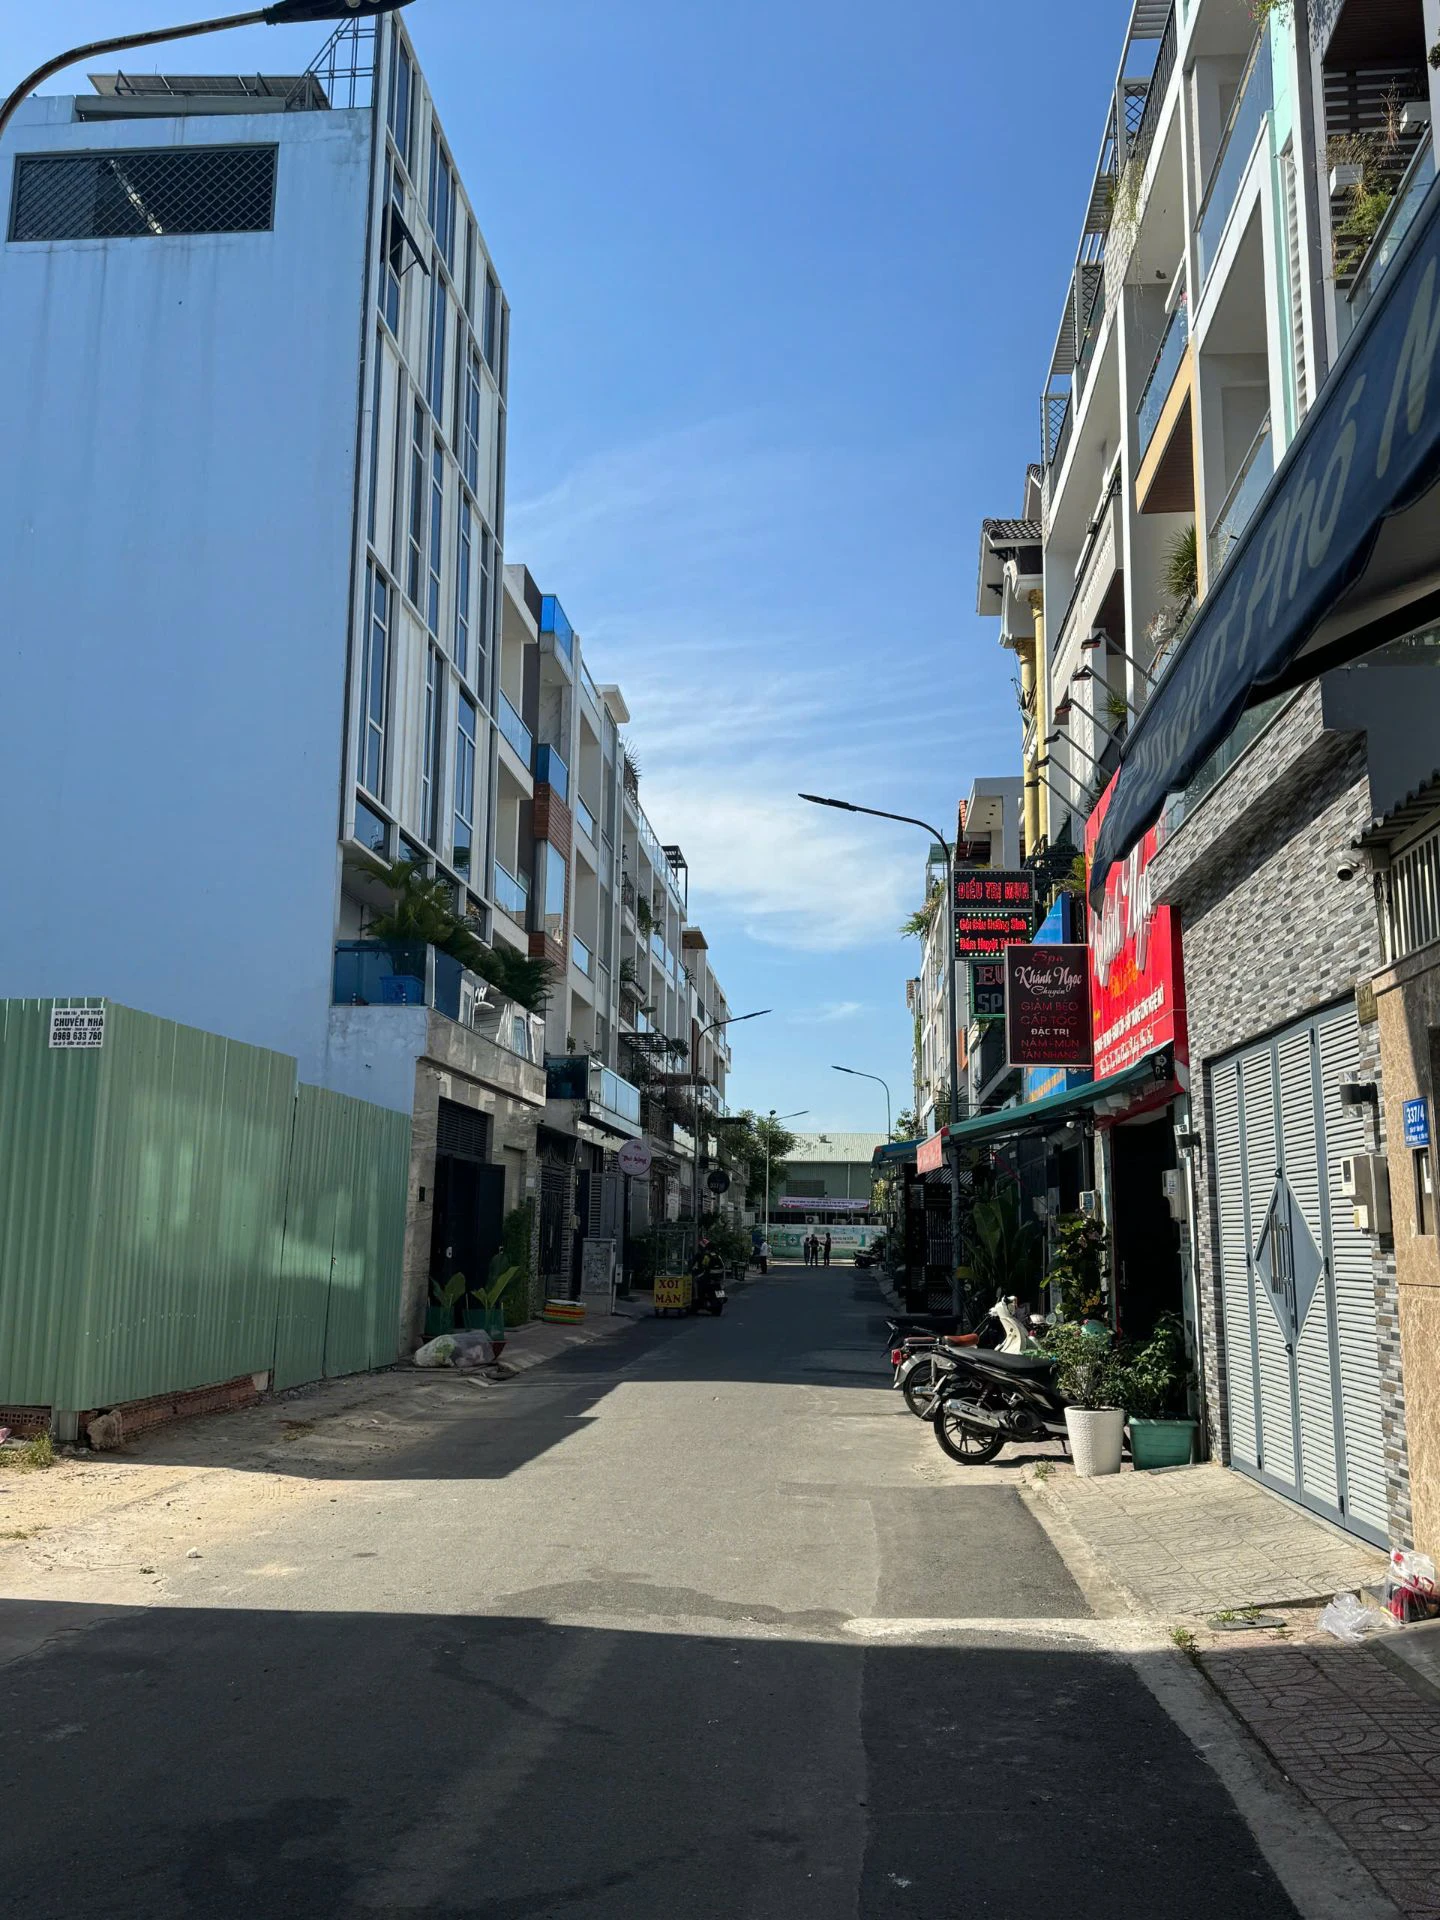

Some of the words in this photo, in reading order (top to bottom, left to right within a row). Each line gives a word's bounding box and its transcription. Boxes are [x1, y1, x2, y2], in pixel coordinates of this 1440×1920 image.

[984, 881, 1002, 903] TRỊ
[1004, 881, 1030, 903] MỤN
[1032, 950, 1064, 966] Spa
[1014, 966, 1052, 989] Khánh
[1053, 966, 1083, 992] Ngọc
[1030, 985, 1066, 998] Chuyên
[1021, 998, 1053, 1011] GIẢM
[54, 1014, 85, 1027] CHUYỂN
[87, 1016, 104, 1027] NHÀ
[1020, 1011, 1047, 1025] CẤP
[73, 1031, 87, 1041] 633
[89, 1031, 102, 1041] 760
[1031, 1026, 1051, 1037] ĐẶC
[1053, 1028, 1070, 1038] TRỊ
[1406, 1104, 1425, 1124] 337/4
